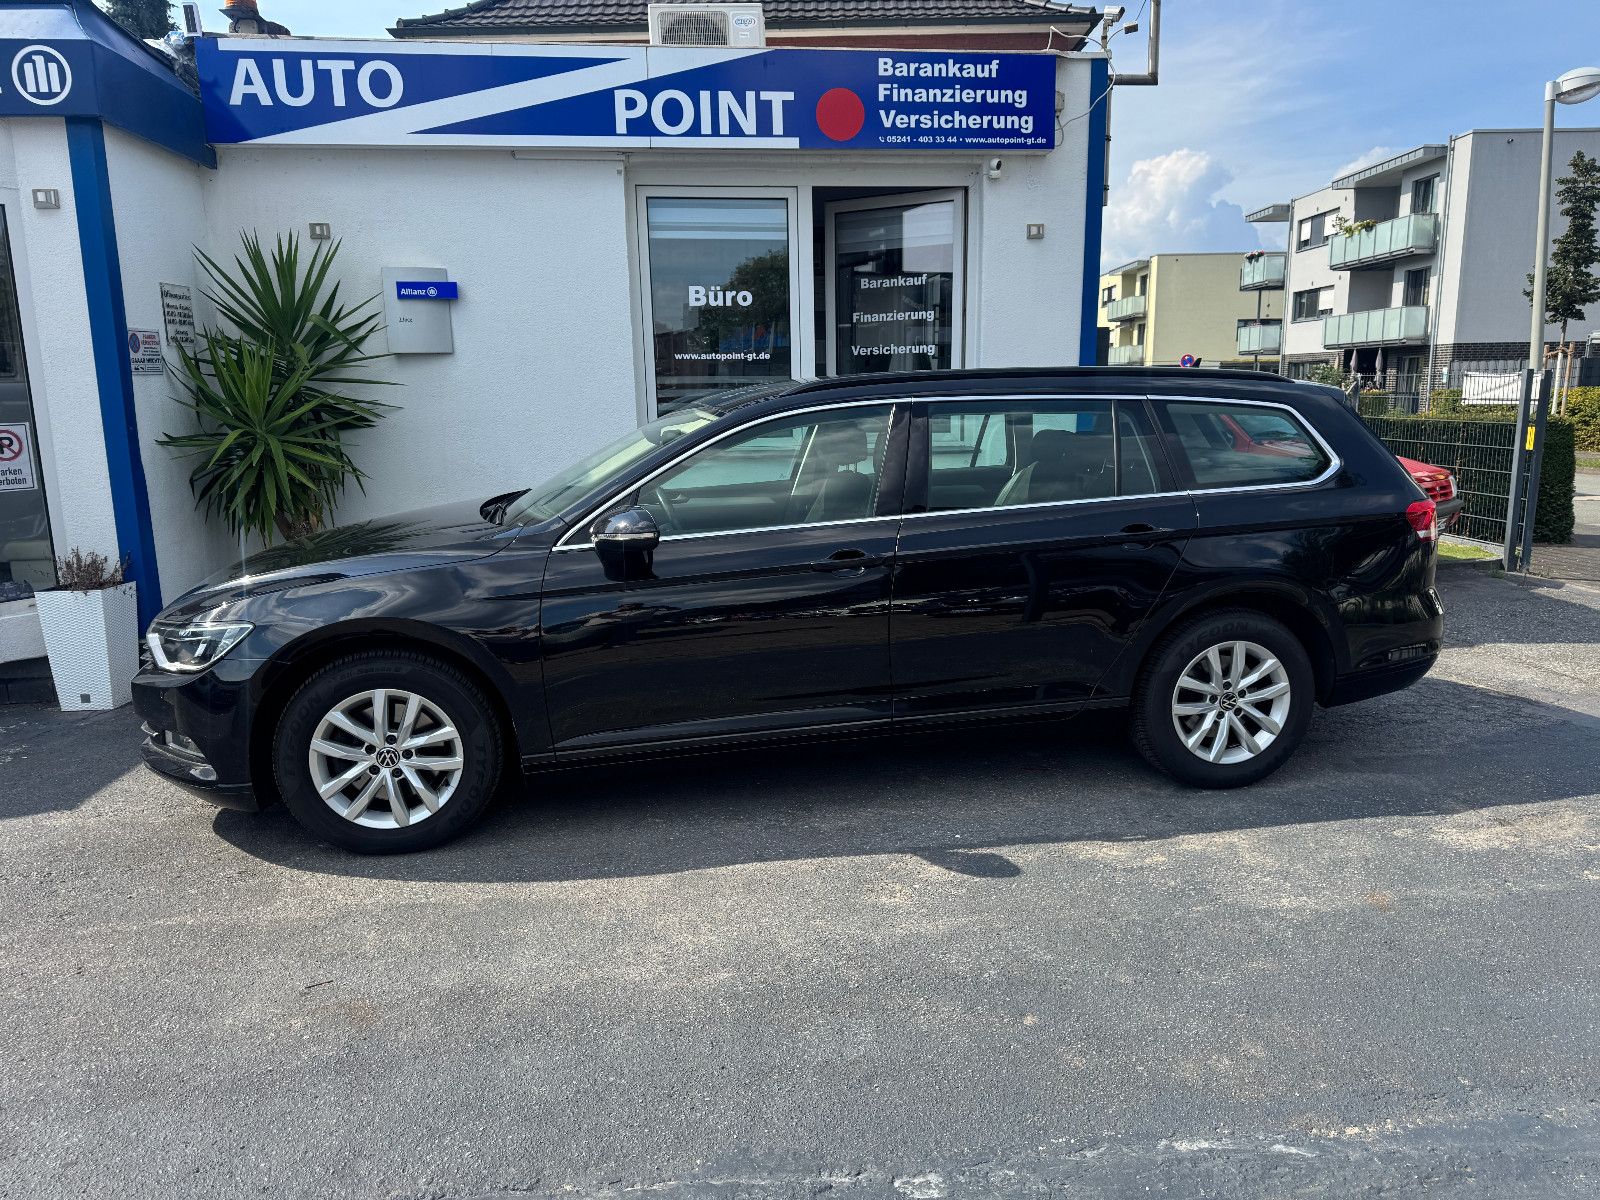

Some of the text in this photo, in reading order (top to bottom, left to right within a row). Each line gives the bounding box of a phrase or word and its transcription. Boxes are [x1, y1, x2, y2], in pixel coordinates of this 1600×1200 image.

[878, 57, 999, 78] Barankauf
[229, 58, 404, 107] AUTO
[878, 84, 1028, 108] Finanzierung
[614, 89, 795, 135] POINT
[879, 109, 1034, 133] Versicherung
[886, 135, 911, 143] 05241
[918, 135, 933, 143] 403
[965, 136, 1047, 145] www.autopoint-gt.de
[860, 273, 928, 289] Barankauf
[400, 287, 426, 296] Allianz
[688, 285, 753, 307] Büro
[852, 310, 935, 322] Finanzierung
[674, 352, 771, 361] www.autopoint-gt.de
[851, 344, 936, 356] Versicherung
[0, 467, 23, 477] arken
[0, 477, 27, 486] erboten
